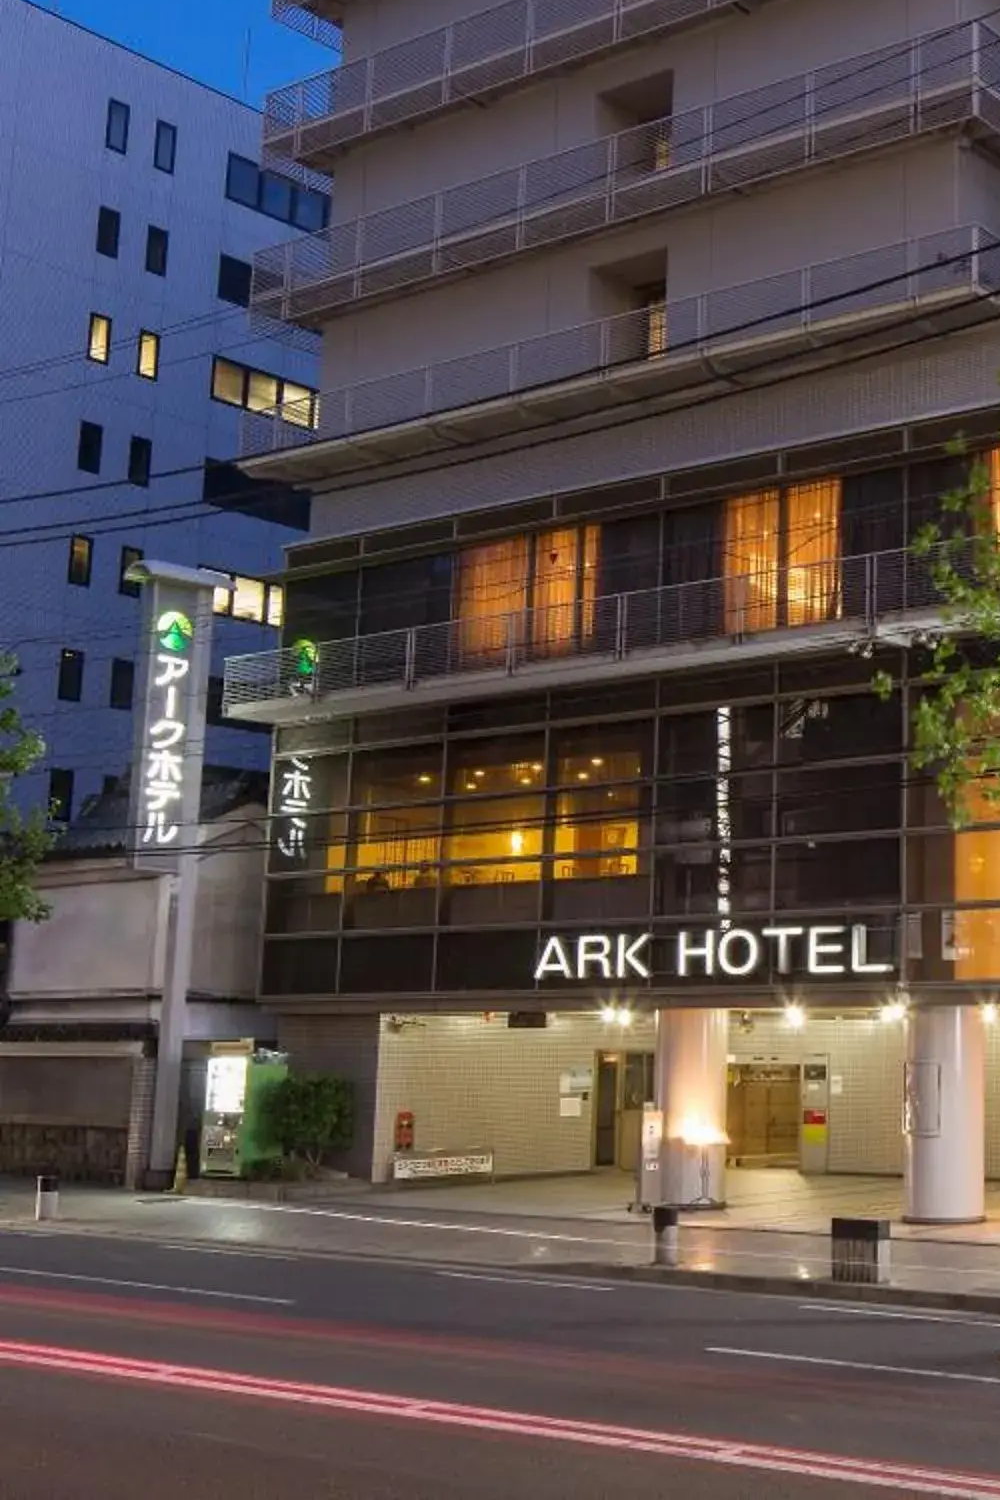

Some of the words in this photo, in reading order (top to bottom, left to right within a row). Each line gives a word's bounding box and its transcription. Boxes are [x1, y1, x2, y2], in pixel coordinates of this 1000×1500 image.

[142, 653, 190, 844] アークホテル
[534, 933, 652, 980] ARK
[676, 924, 895, 977] HOTEL
